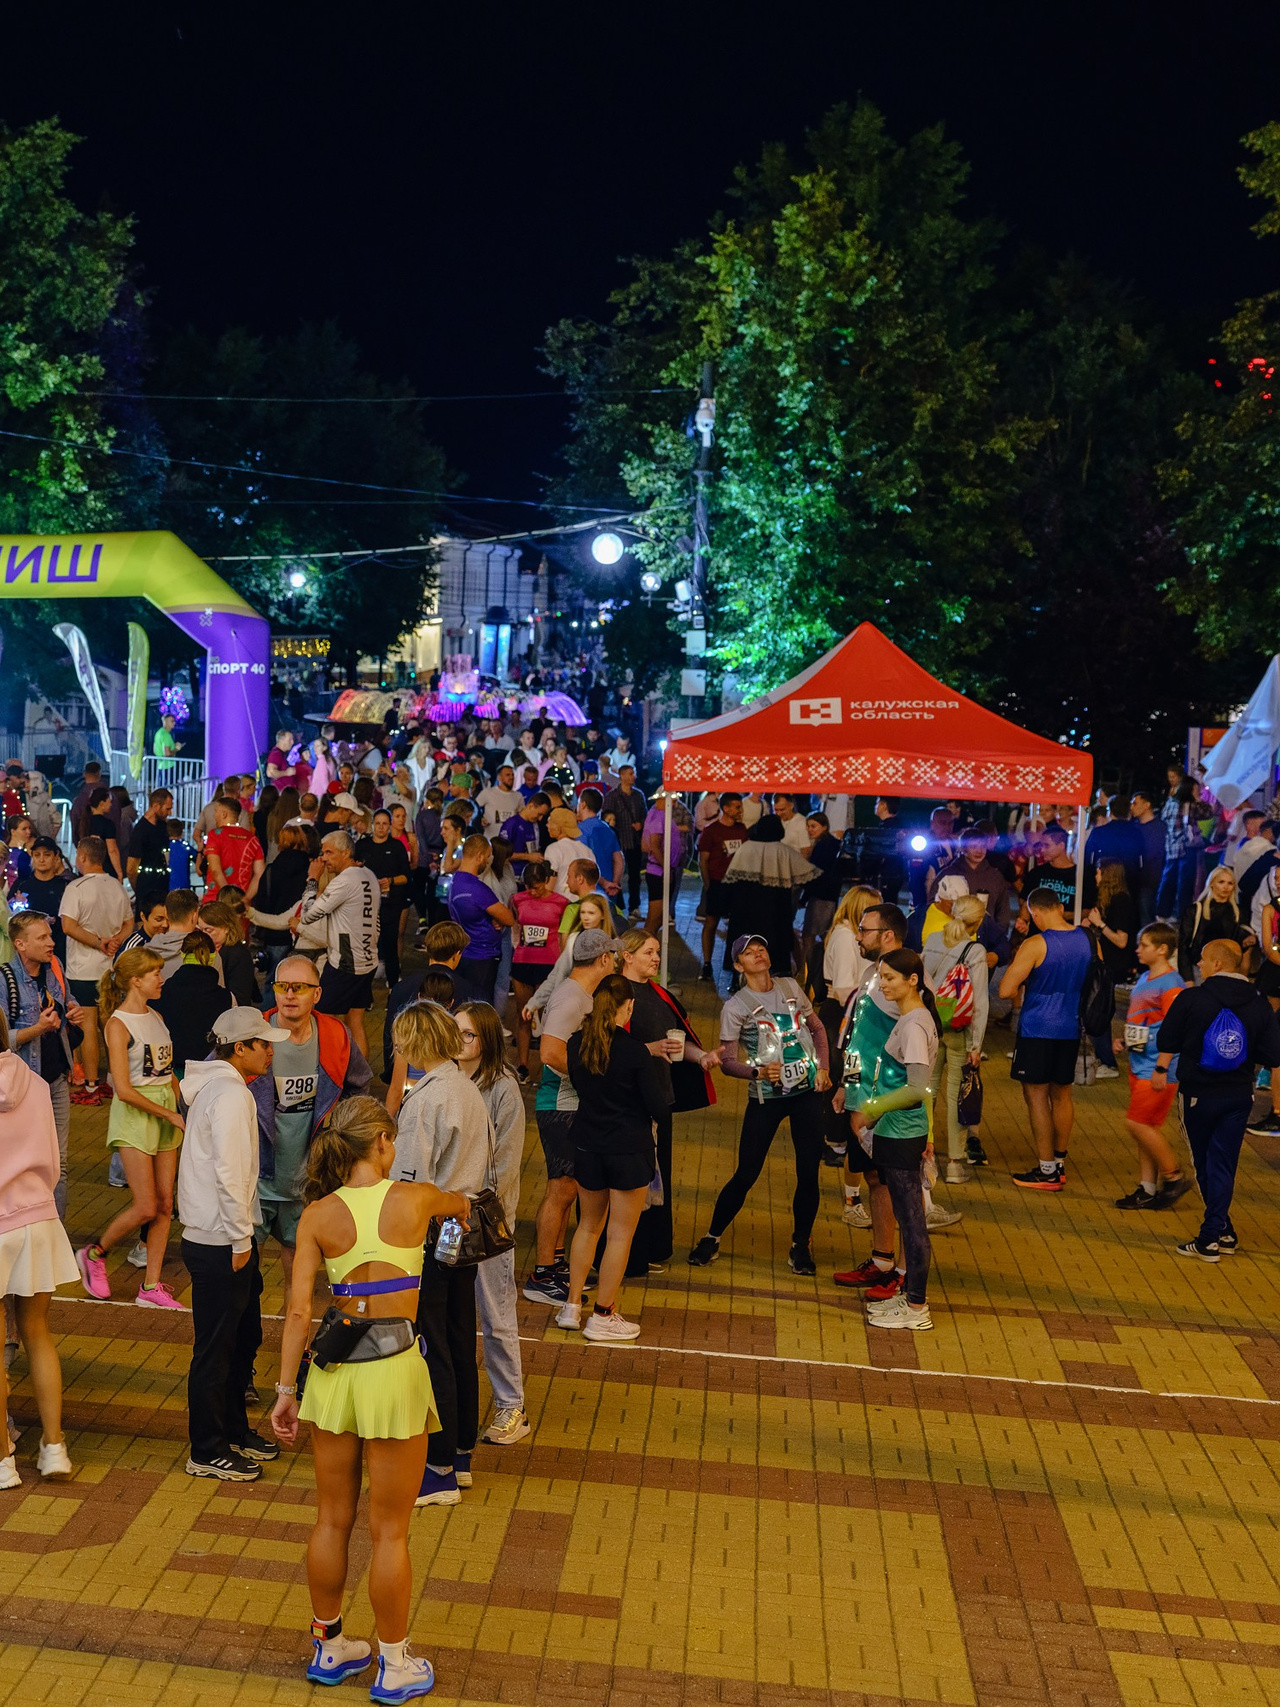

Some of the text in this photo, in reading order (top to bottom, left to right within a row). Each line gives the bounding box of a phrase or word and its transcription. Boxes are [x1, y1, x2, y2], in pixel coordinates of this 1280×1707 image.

[251, 663, 266, 674] 40
[850, 700, 959, 710] калужская
[850, 710, 935, 720] область
[361, 881, 372, 918] RUN
[528, 927, 545, 937] 389
[285, 1077, 314, 1095] 298
